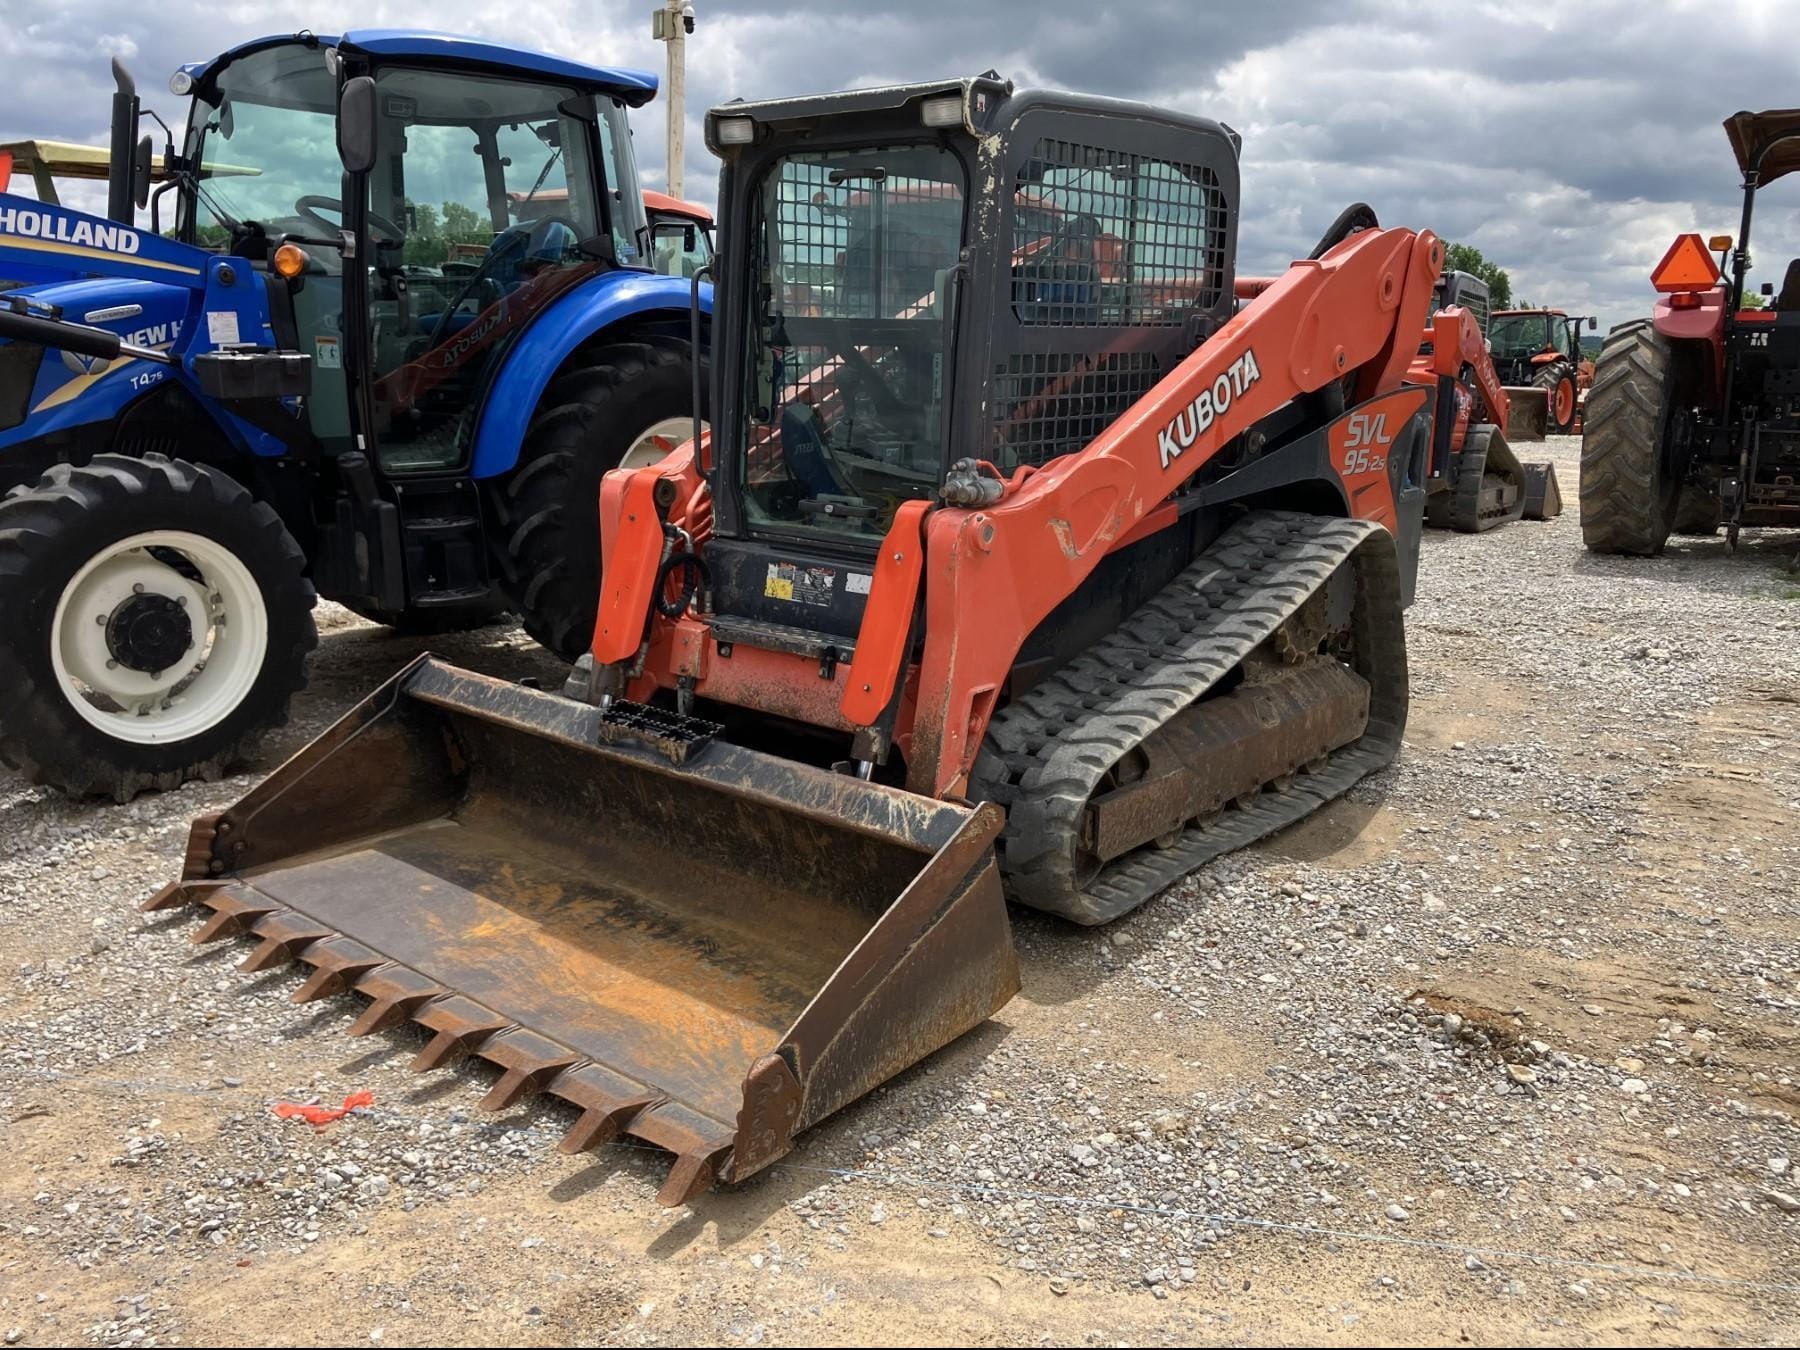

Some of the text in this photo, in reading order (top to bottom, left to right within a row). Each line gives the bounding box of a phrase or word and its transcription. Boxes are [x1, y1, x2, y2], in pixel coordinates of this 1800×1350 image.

[0, 206, 139, 254] HOLLAND
[120, 323, 167, 347] NEW
[1157, 350, 1261, 469] KUBOTA
[1344, 413, 1391, 447] SVL
